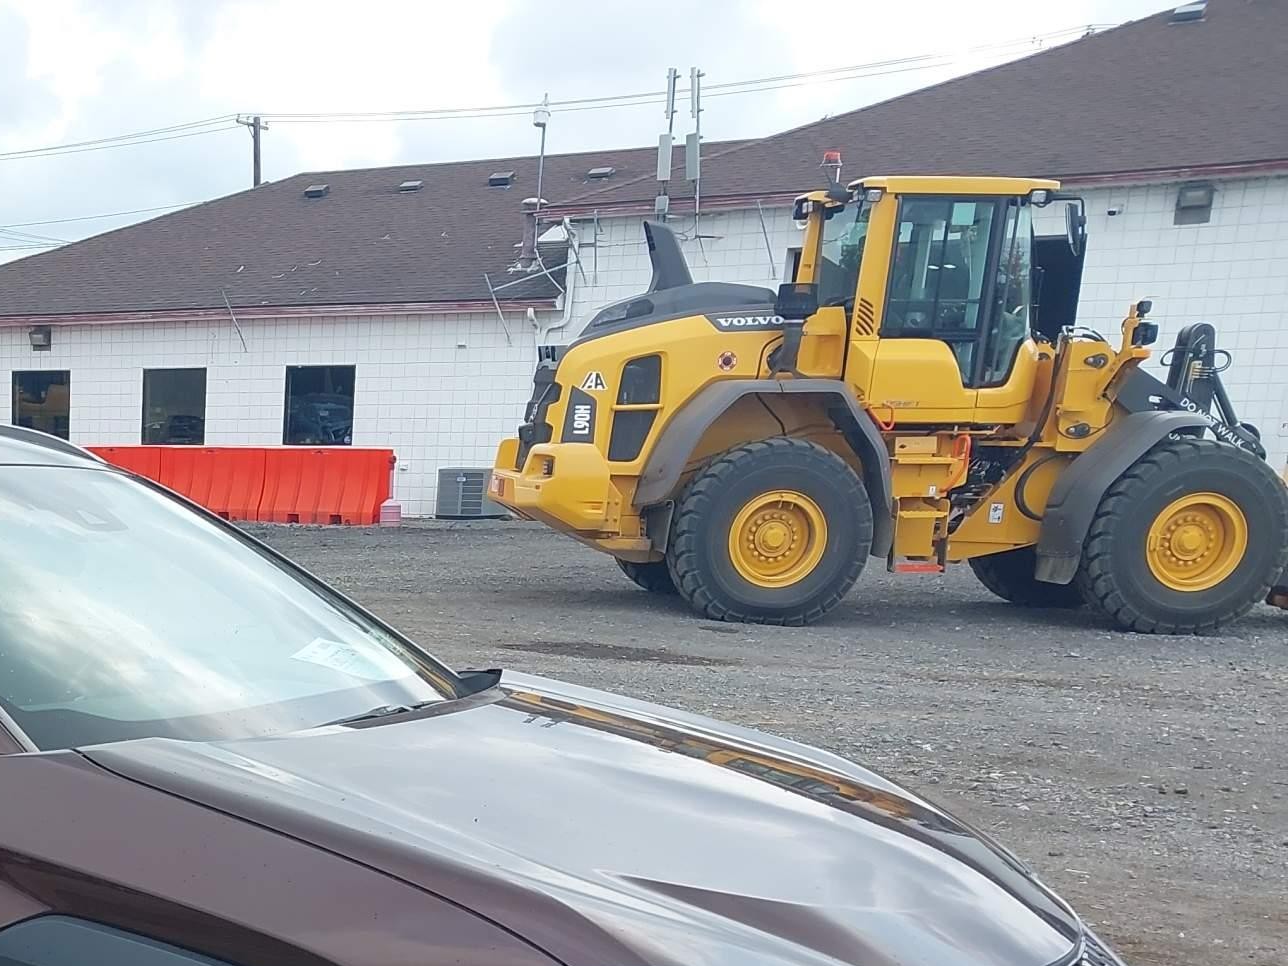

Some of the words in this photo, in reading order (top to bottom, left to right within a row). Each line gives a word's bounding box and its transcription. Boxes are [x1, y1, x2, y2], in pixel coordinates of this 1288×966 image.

[716, 315, 785, 327] VOLVO
[572, 404, 592, 435] L90H
[1180, 397, 1197, 412] DO
[1217, 424, 1246, 448] WALK
